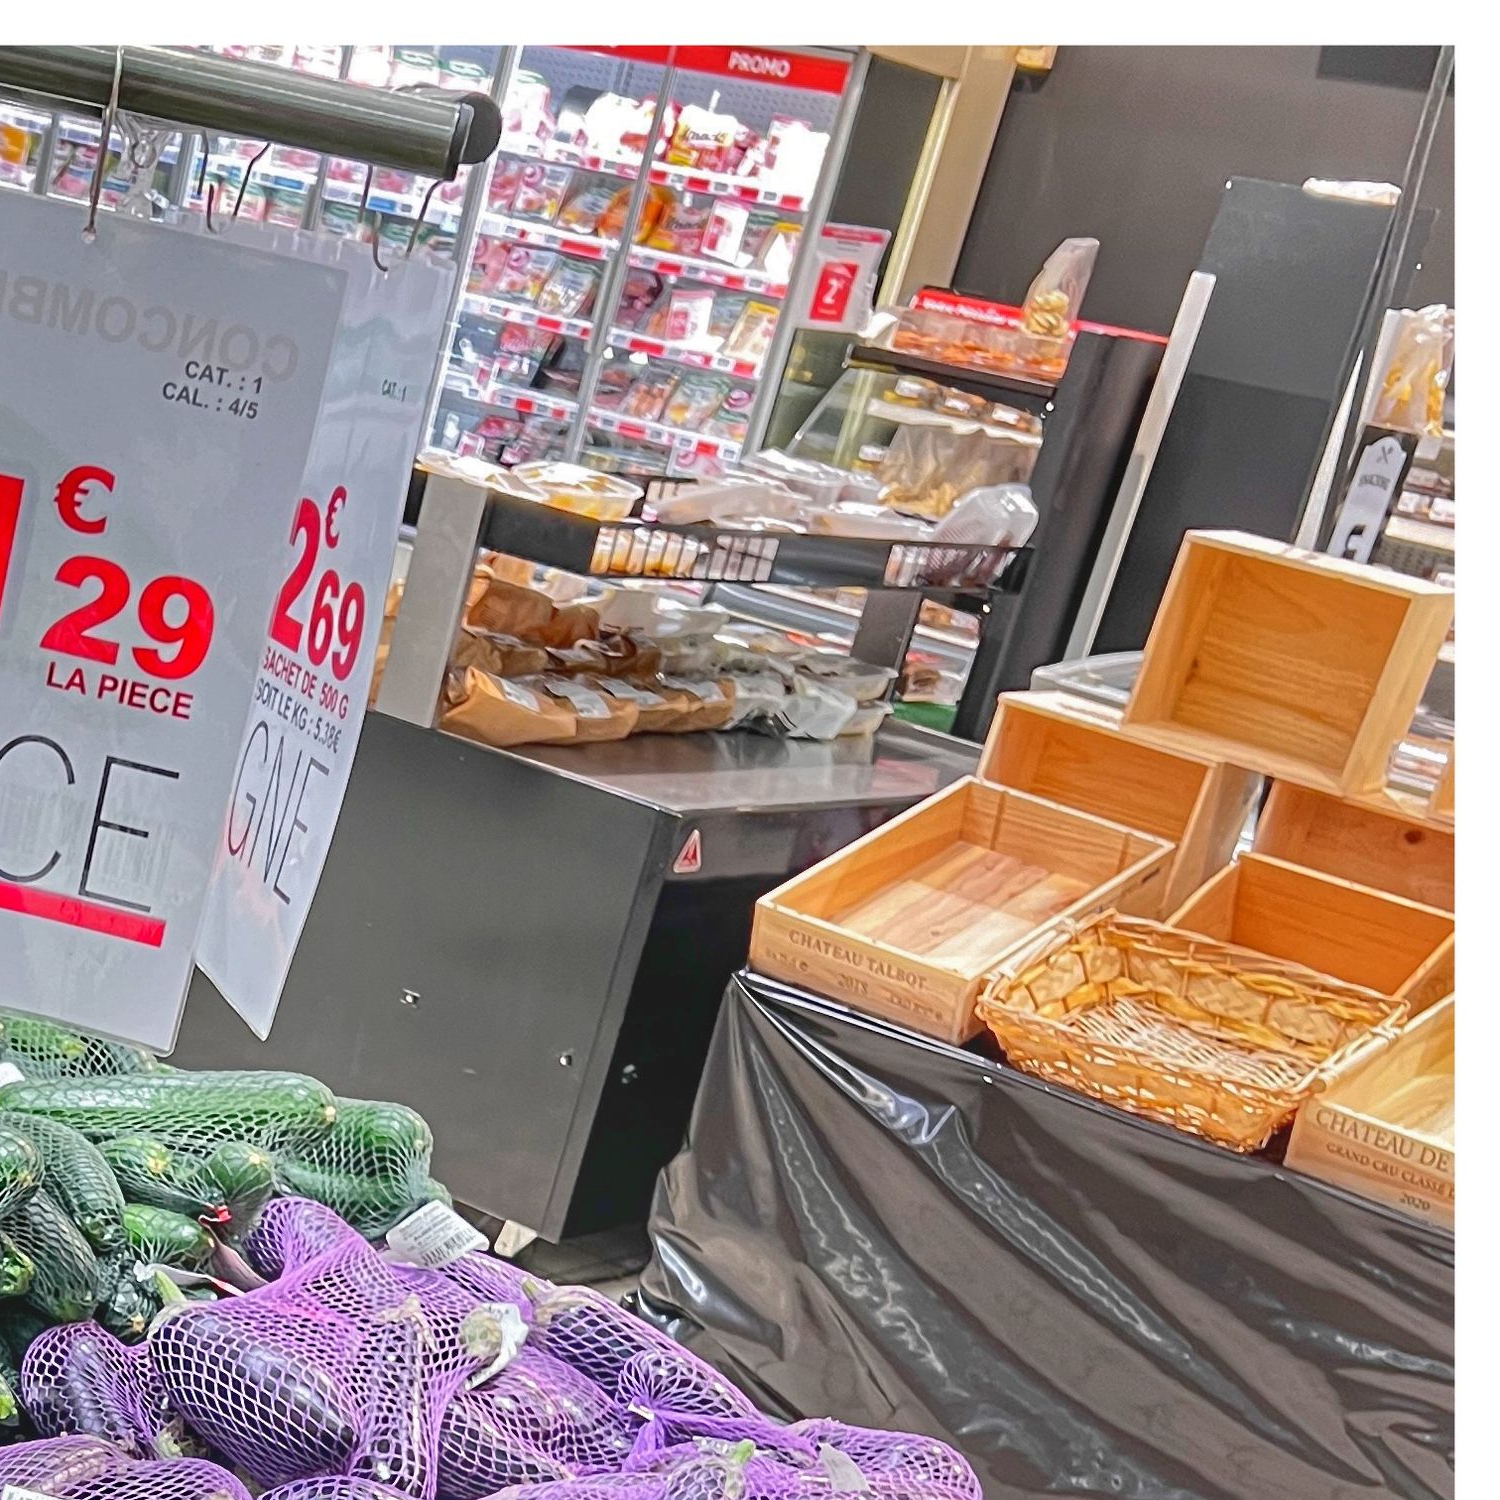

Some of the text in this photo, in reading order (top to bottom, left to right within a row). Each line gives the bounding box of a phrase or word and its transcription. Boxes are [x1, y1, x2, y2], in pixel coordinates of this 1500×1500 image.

[728, 51, 791, 79] PROMO
[185, 360, 233, 389] CAT.
[253, 376, 263, 395] 1
[162, 383, 210, 410] CAL.
[228, 397, 259, 420] 4/5
[267, 497, 321, 653] 2
[307, 569, 366, 682] 69
[39, 555, 215, 681] 29
[46, 661, 195, 720] LA PIECE
[254, 677, 280, 711] SOIT
[319, 681, 340, 714] 500
[788, 930, 863, 968] CHATEAU
[866, 956, 928, 989] TALBOT
[1316, 1108, 1451, 1173] CHATEAU DE
[1326, 1142, 1370, 1167] GRAND
[1372, 1159, 1399, 1177] CRU
